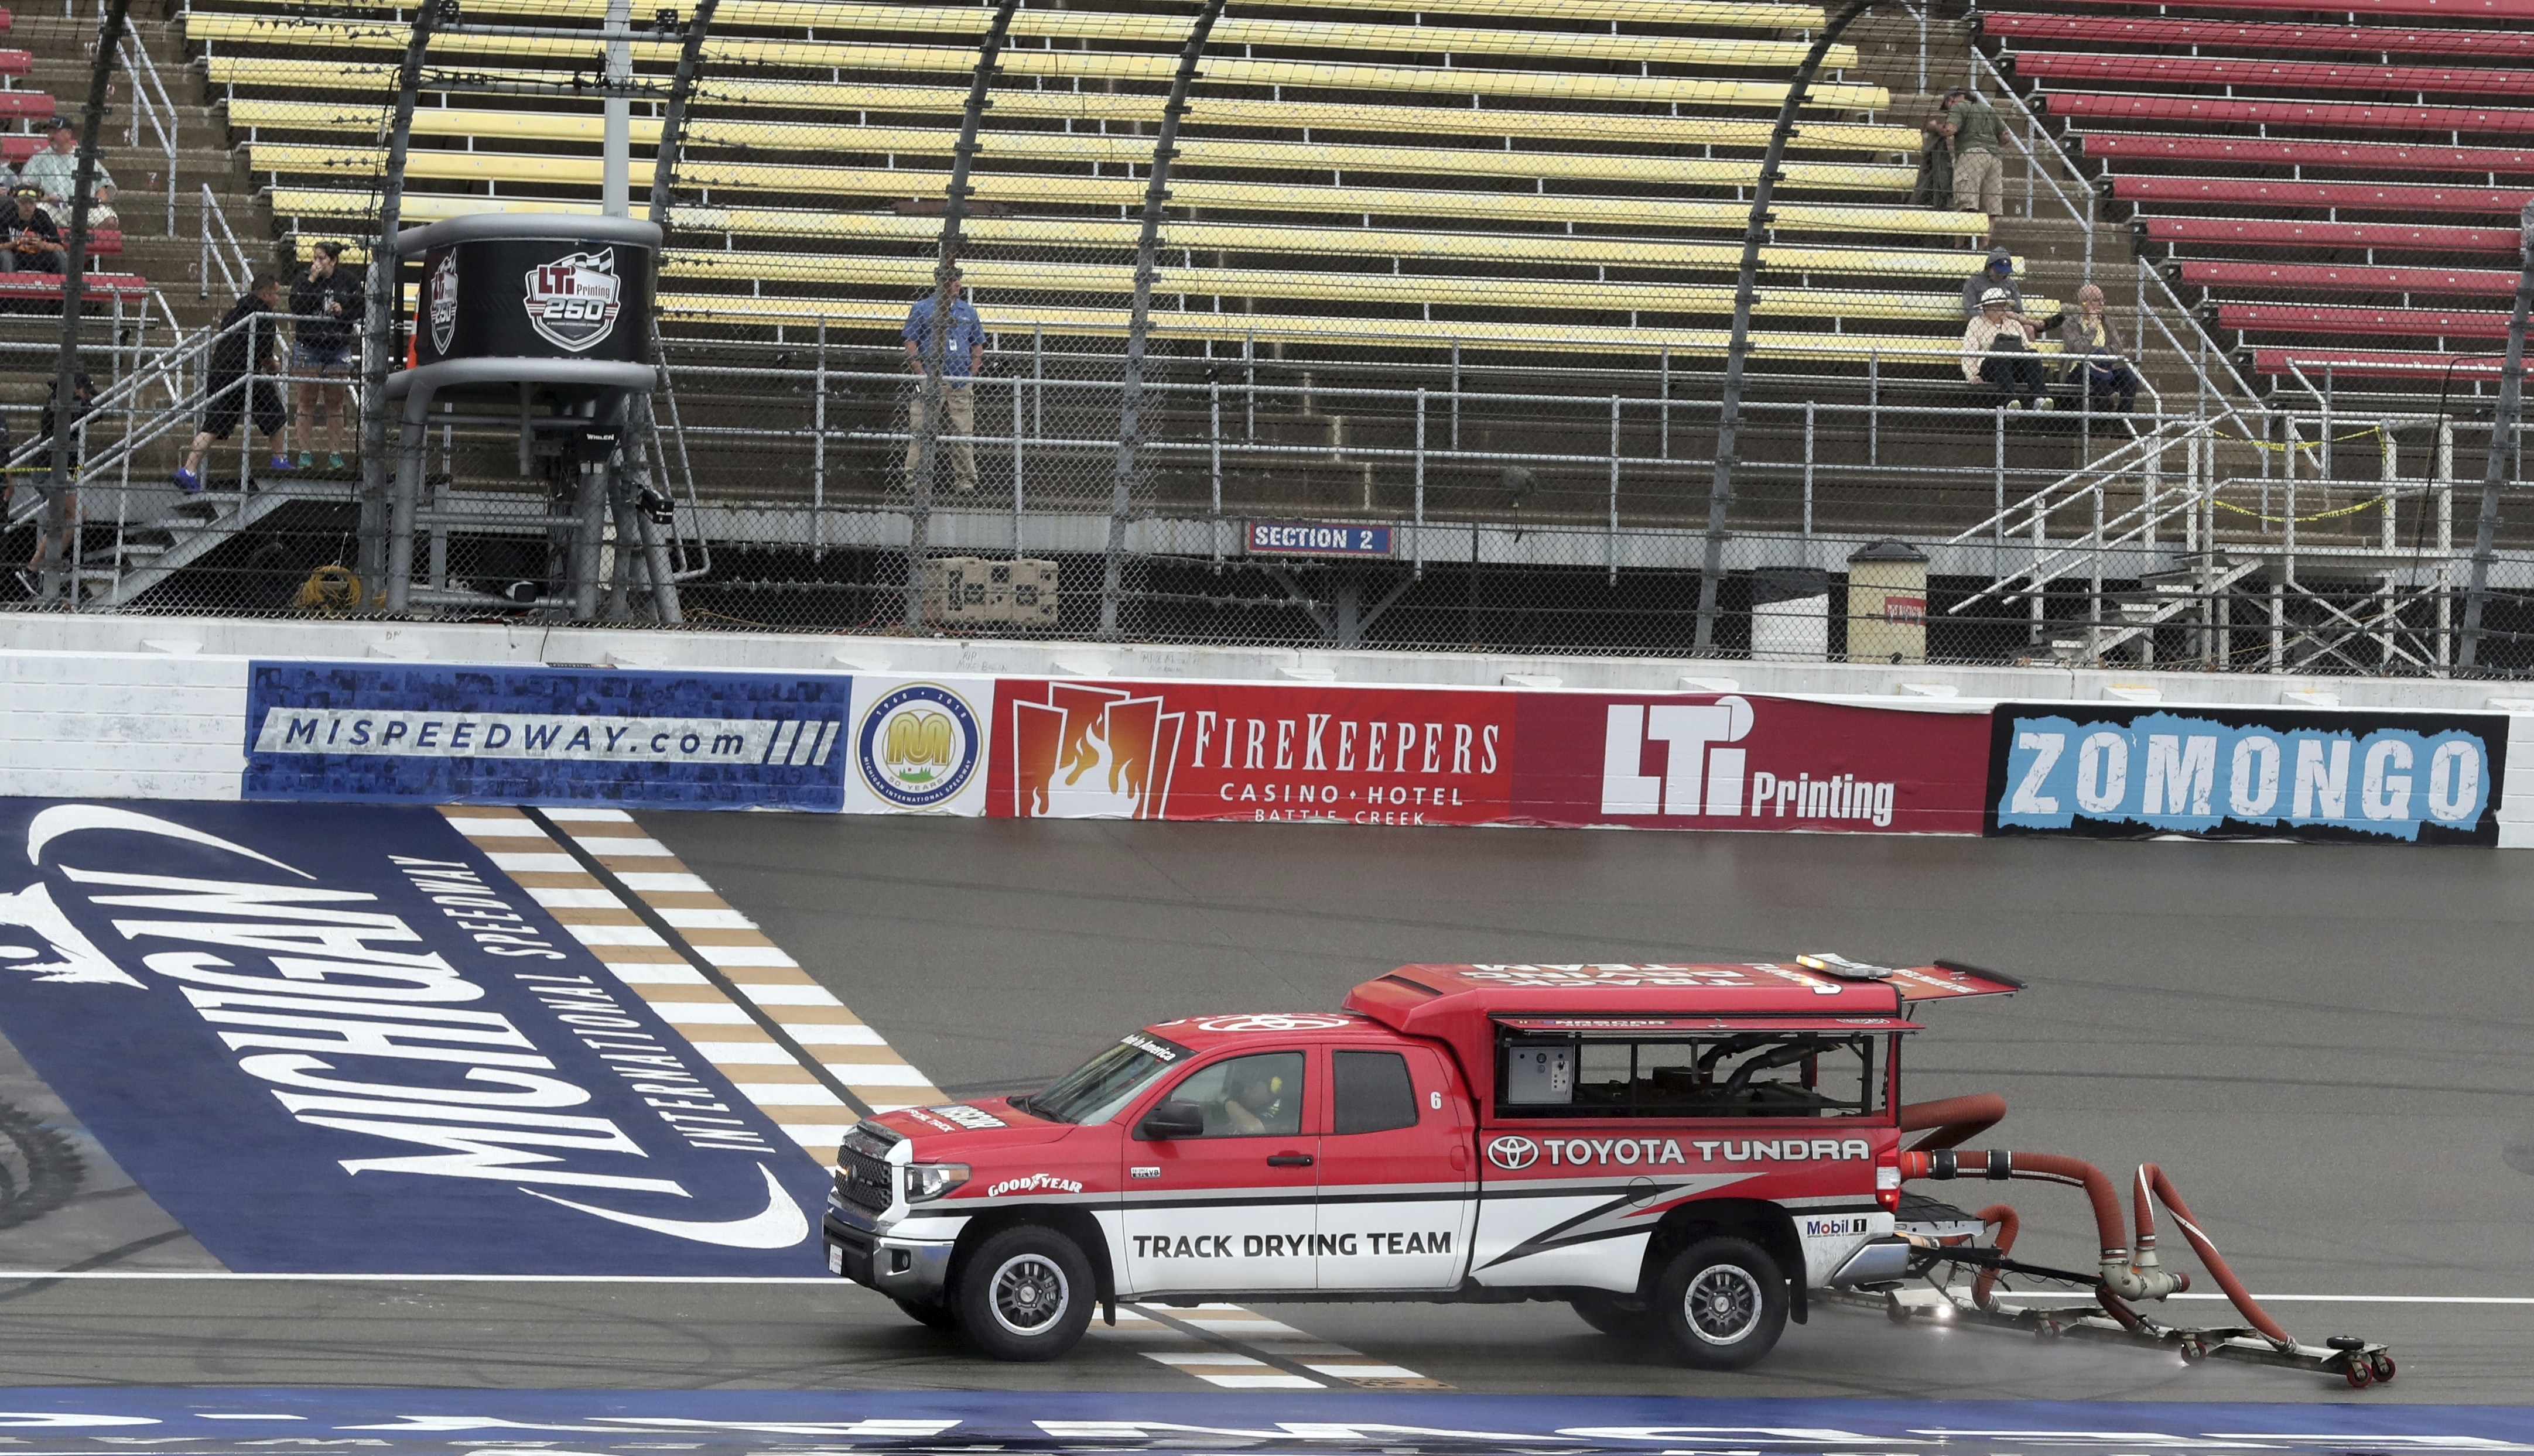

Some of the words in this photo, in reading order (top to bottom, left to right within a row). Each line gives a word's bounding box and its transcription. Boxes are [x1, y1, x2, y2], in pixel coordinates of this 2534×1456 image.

[577, 284, 610, 299] Printing
[436, 303, 452, 324] 250
[542, 298, 606, 321] 250
[1254, 526, 1348, 549] SECTION
[1359, 530, 1373, 550] 2
[962, 651, 977, 662] RIP
[876, 693, 908, 716] 1968
[938, 693, 966, 718] 2018
[285, 717, 744, 755] MISPEEDWAY.com
[1191, 710, 1500, 775] FIREKEEPERS
[863, 756, 885, 790] MICHIGAN
[885, 789, 943, 803] INTERNATIONAL
[945, 759, 972, 793] SPEEDWAY
[888, 776, 901, 787] 50
[908, 777, 944, 792] YEARS
[2010, 732, 2480, 821] ZOMONGO
[1220, 782, 1339, 804] CASINO
[1367, 786, 1463, 807] HOTEL
[1750, 771, 1896, 827] Printing
[1355, 810, 1425, 825] CREEK
[387, 855, 567, 960] SPEEDWAY
[58, 864, 693, 1198] MICHIGAN
[514, 973, 777, 1153] INTERNATIONAL
[1138, 1040, 1176, 1061] America
[1430, 1091, 1442, 1110] 6
[1543, 1139, 1686, 1165] TOYOTA
[1692, 1139, 1869, 1161] TUNDRA
[1807, 1219, 1849, 1235] Mobil
[1132, 1235, 1234, 1258] TRACK
[1243, 1234, 1358, 1258] DRYING
[1366, 1231, 1452, 1255] TEAM
